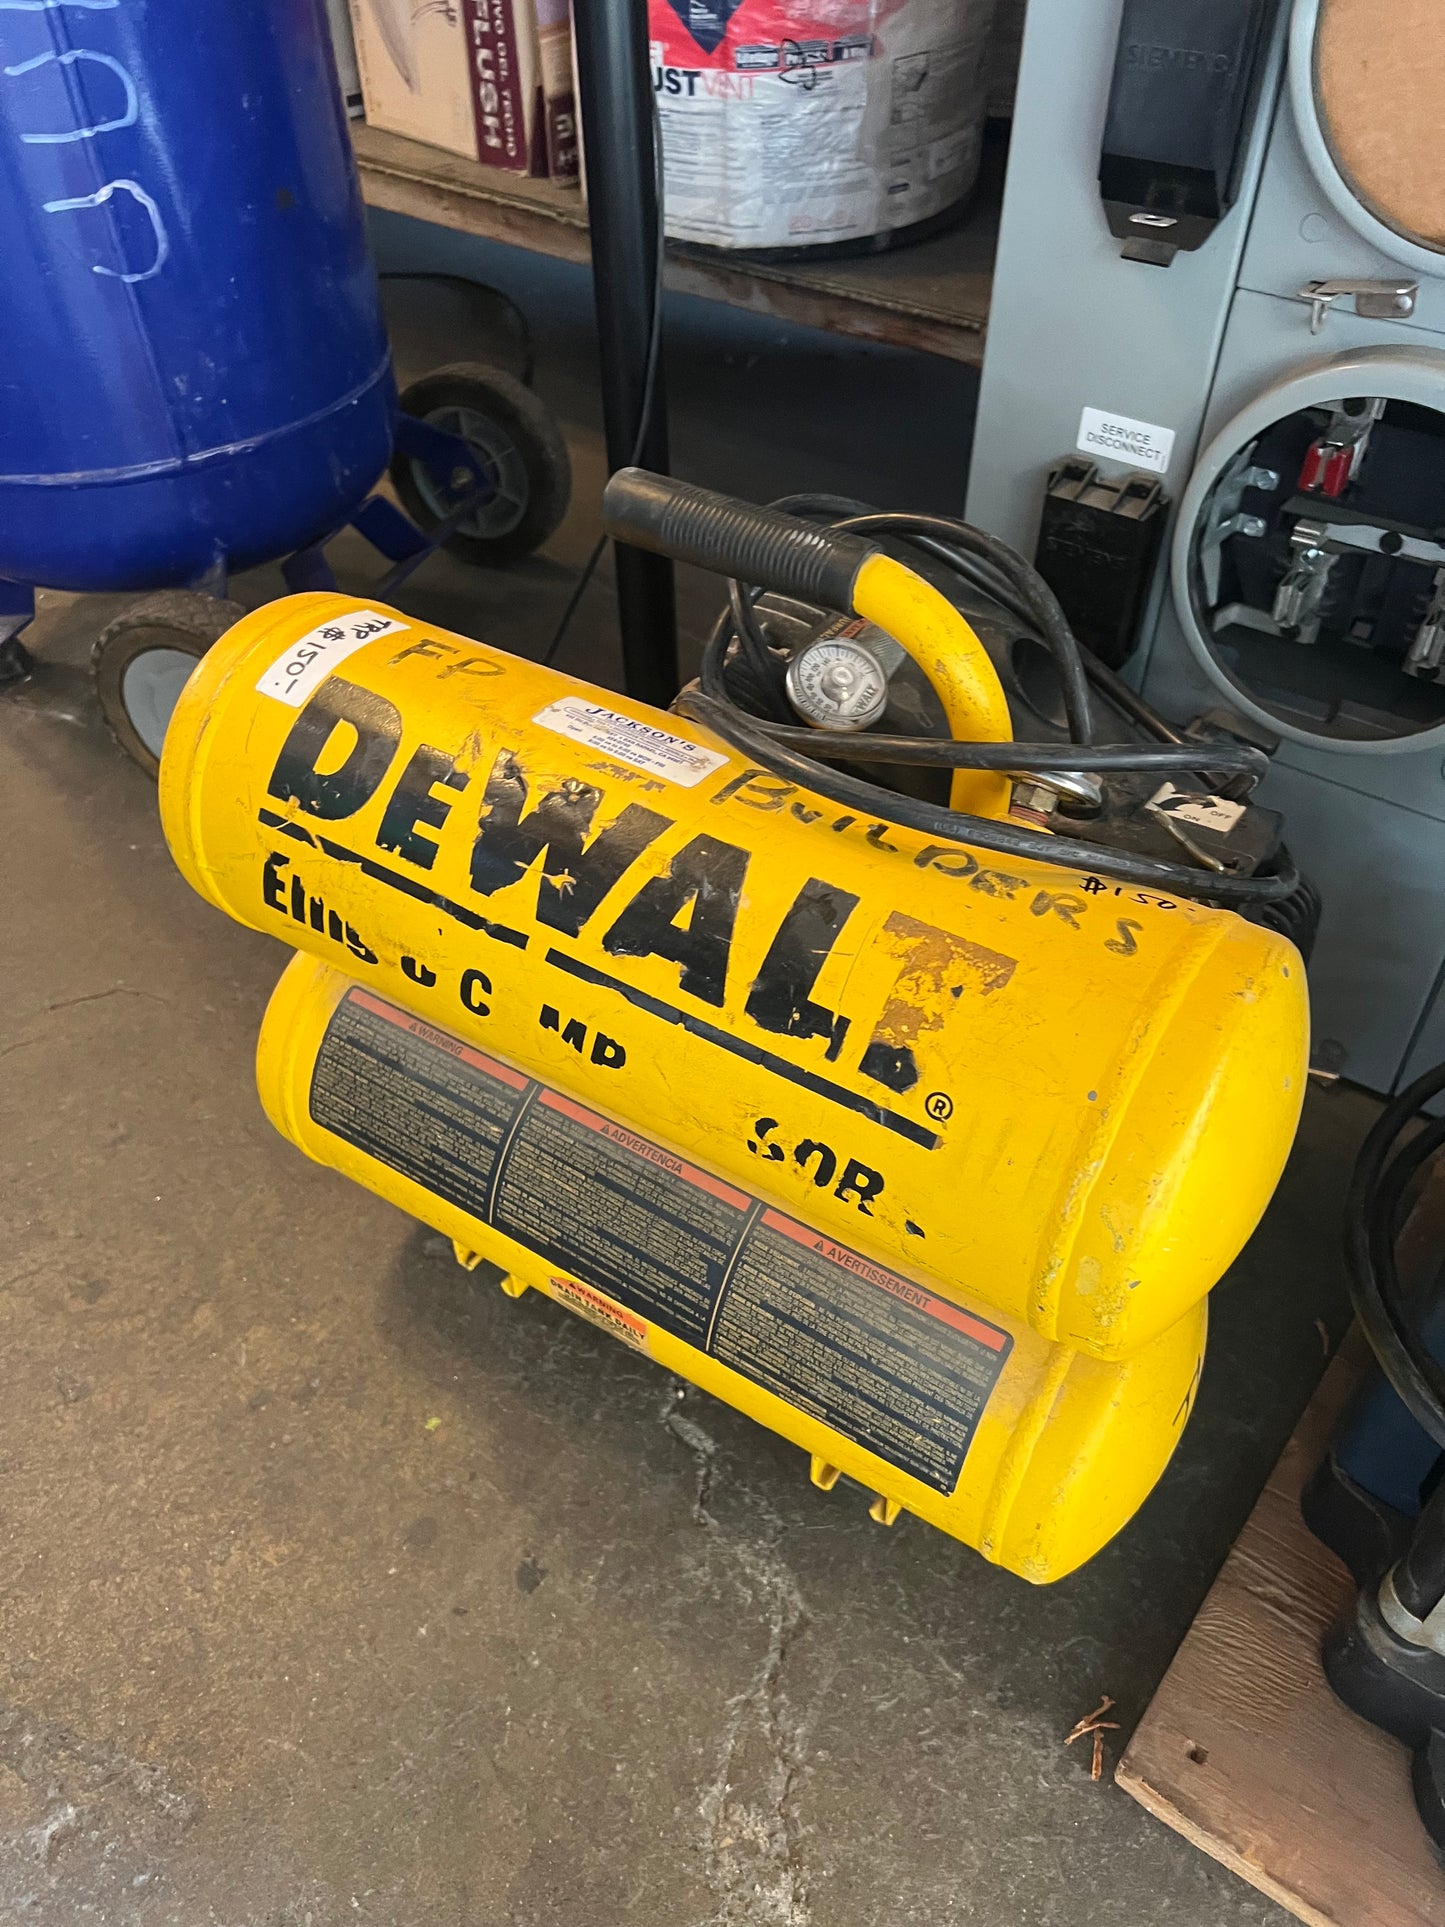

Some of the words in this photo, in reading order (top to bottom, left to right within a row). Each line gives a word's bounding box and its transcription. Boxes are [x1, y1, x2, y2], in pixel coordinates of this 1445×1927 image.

[1086, 431, 1162, 462] DISCONNECT
[1100, 422, 1151, 446] SERVICE
[585, 708, 697, 752] JACKSON'S
[1183, 813, 1201, 822] ON
[1209, 811, 1232, 819] OFF
[266, 674, 1019, 1094] DEWALT
[418, 1024, 464, 1057] WARNING
[611, 1127, 684, 1176] ADVERTENCIA
[826, 1245, 932, 1310] AVERTISSEMENT
